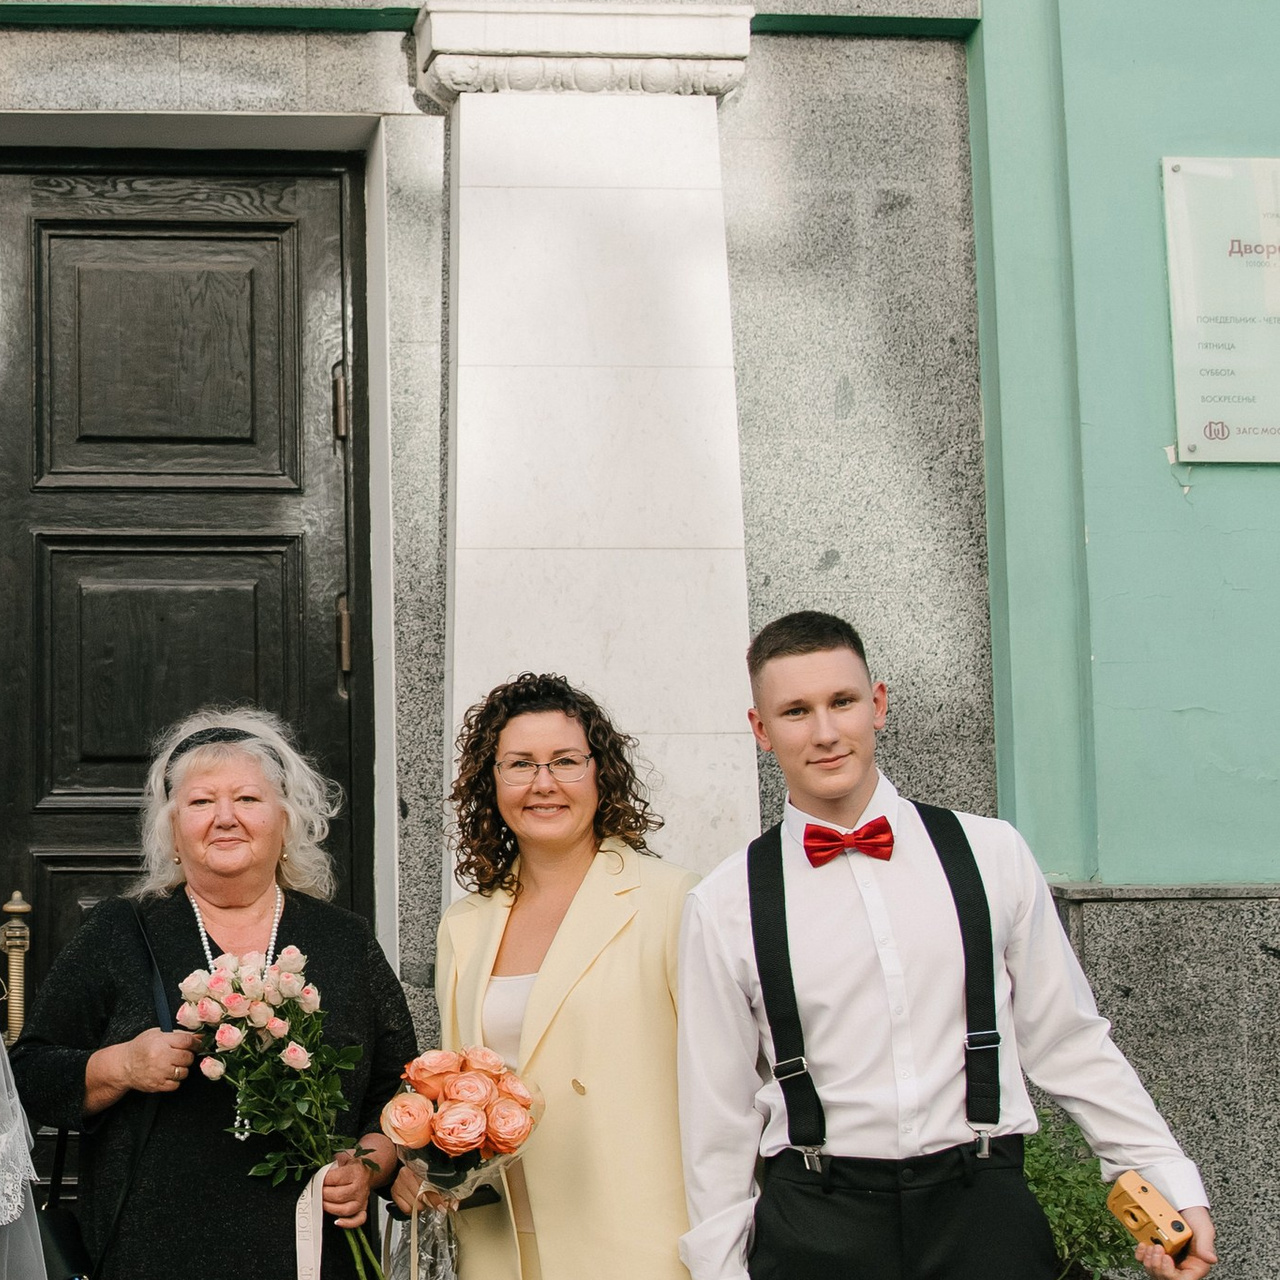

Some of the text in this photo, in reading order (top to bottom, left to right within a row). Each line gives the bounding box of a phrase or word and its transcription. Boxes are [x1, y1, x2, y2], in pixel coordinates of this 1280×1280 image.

[1228, 239, 1280, 260] Двор
[1196, 315, 1256, 324] ПОНЕДЕЛЬНИК
[1197, 342, 1236, 351] ПЯТНИЦА
[1199, 368, 1236, 377] СУББОТА
[1200, 395, 1257, 404] ВОСКРЕСЕНЬЕ
[1235, 426, 1259, 436] ЗАГС
